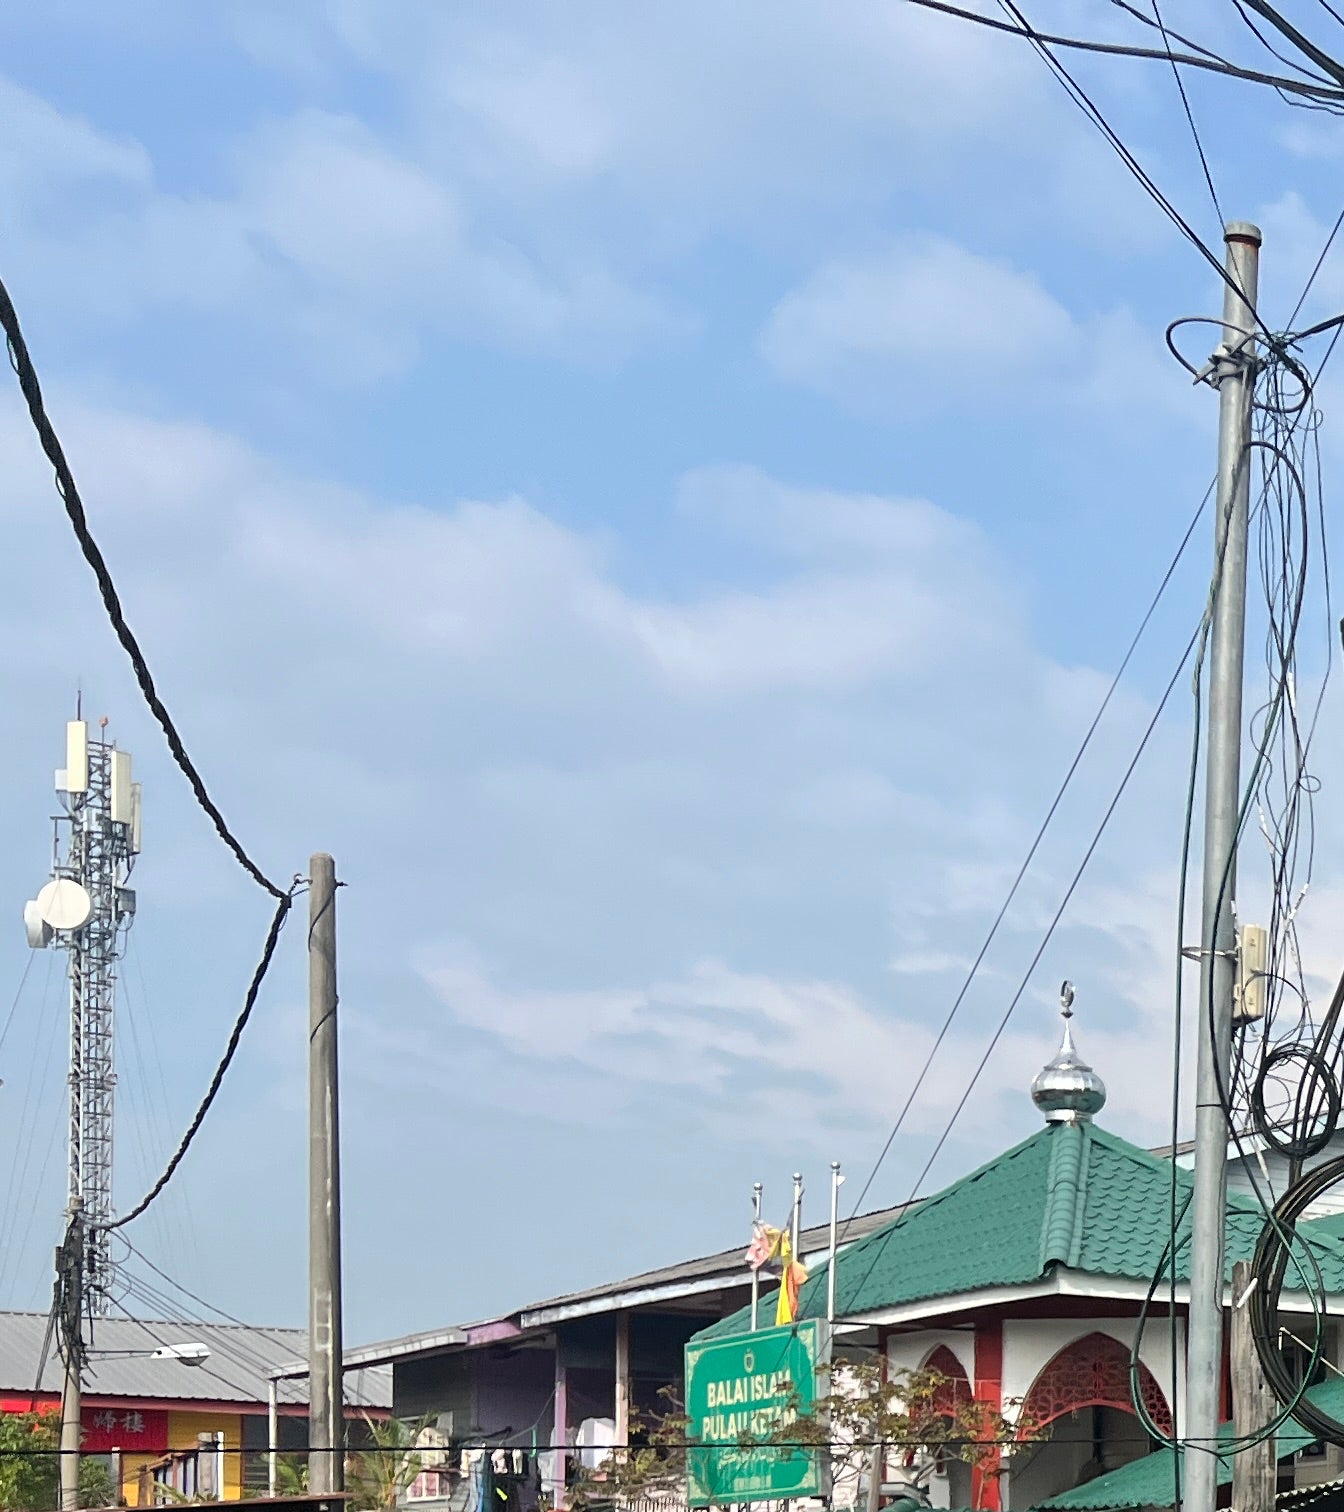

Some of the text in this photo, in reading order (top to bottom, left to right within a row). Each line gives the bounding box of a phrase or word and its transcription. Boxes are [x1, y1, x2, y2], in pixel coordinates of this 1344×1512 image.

[707, 1369, 791, 1408] BALAI ISLAM
[702, 1411, 747, 1441] PULAU
